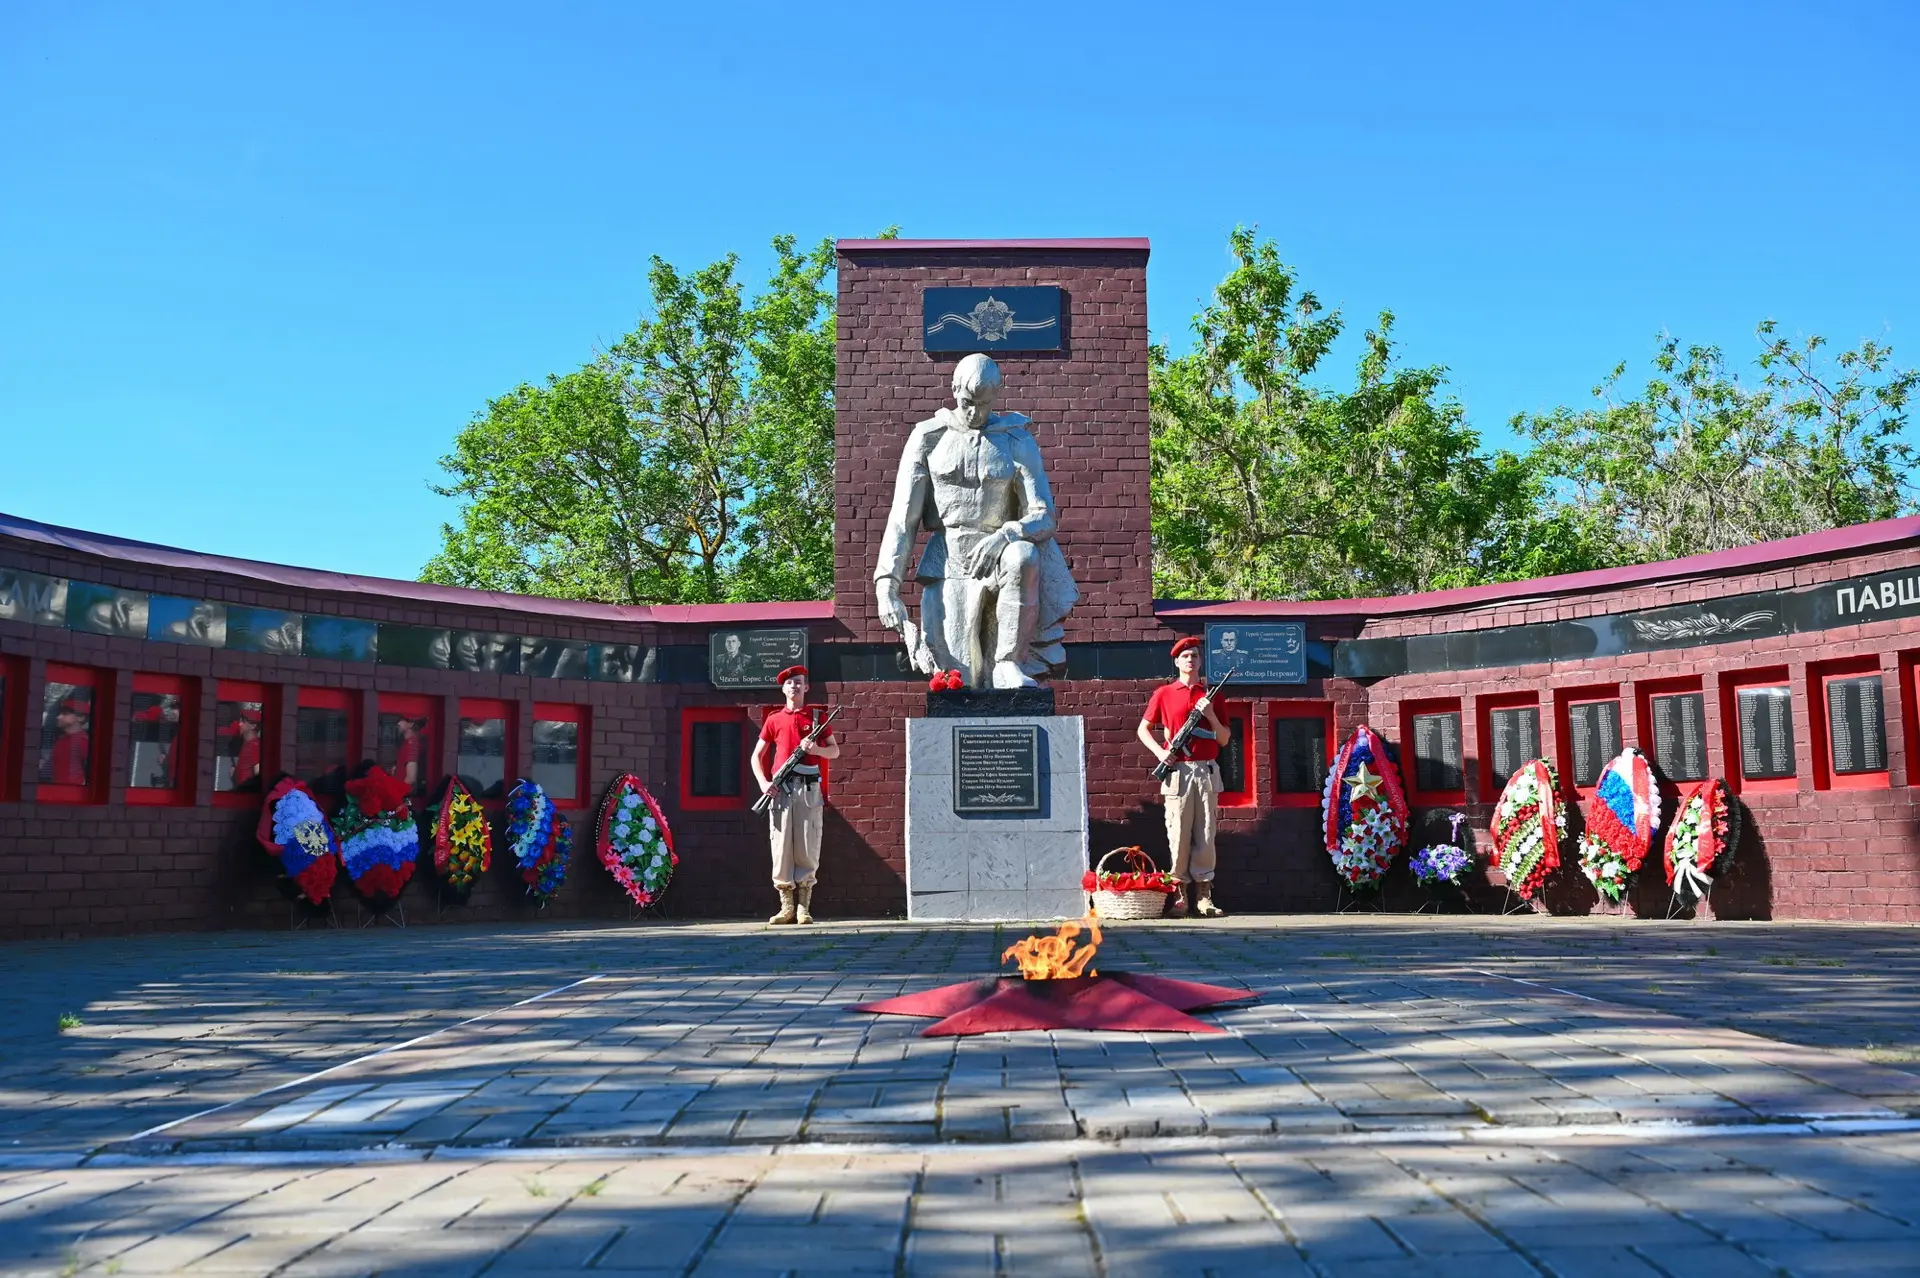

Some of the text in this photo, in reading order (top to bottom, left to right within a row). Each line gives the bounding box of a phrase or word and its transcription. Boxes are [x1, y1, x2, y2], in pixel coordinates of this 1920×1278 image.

[1836, 576, 1920, 615] ПАВШ
[1266, 670, 1298, 678] Петрович
[742, 675, 762, 684] Борис
